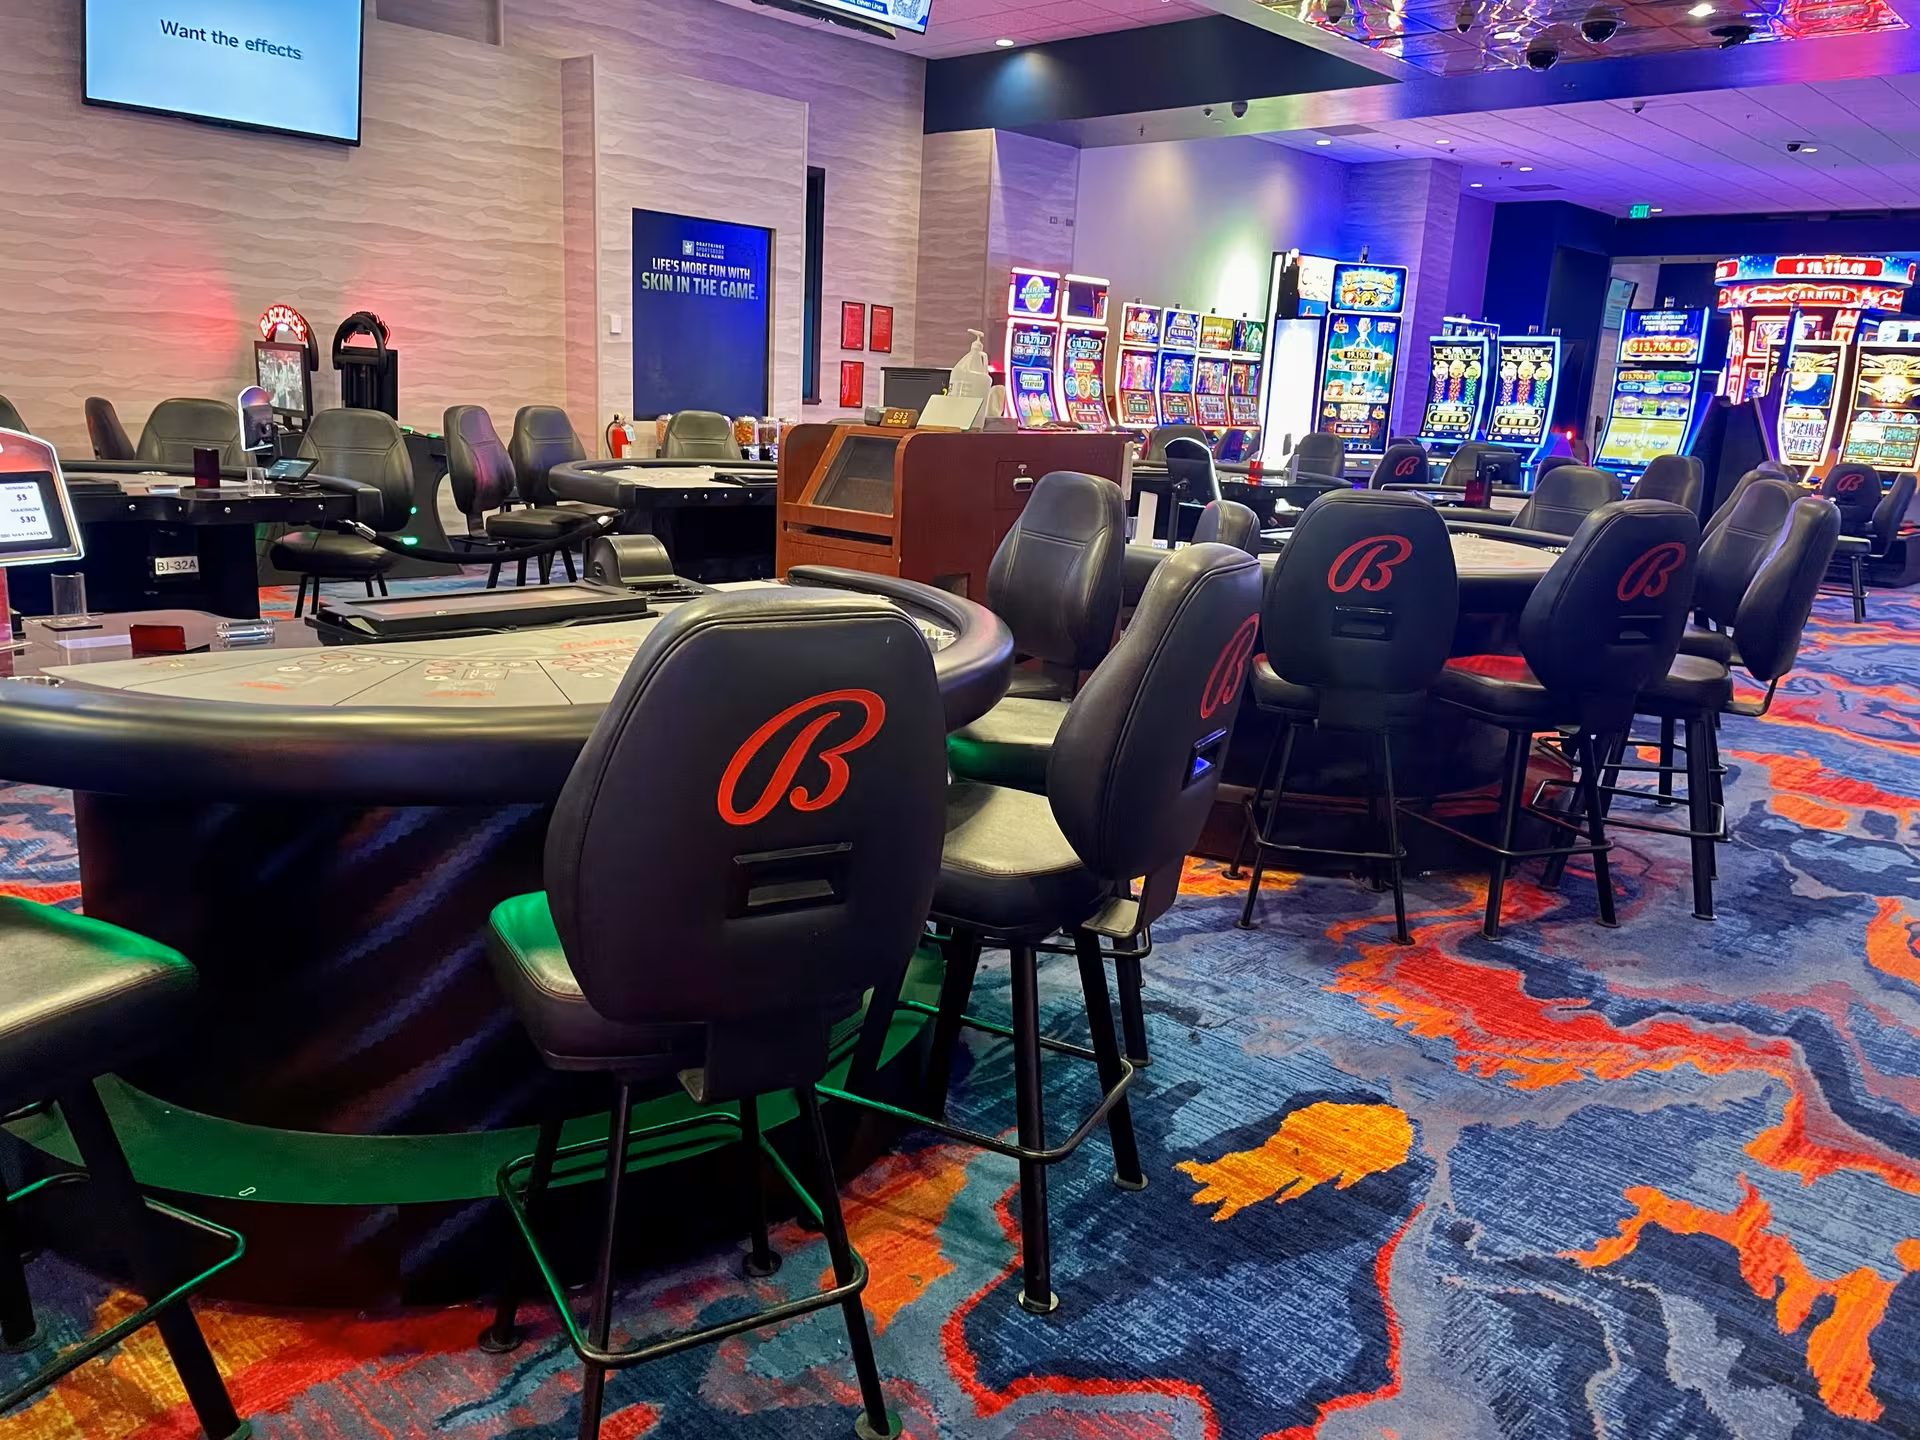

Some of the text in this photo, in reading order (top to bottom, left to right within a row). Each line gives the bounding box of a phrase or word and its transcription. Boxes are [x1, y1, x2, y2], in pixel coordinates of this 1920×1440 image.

[160, 19, 303, 60] Want the effects
[696, 241, 725, 249] DRAFTKINGS
[652, 257, 750, 280] LIFE'S MORE FUN WITH
[641, 272, 759, 300] SKIN IN THE GAME.
[1787, 289, 1851, 302] CARNIVAL
[259, 306, 306, 342] BLACKJACK
[1632, 341, 1688, 353] $13,706.89
[157, 559, 197, 572] BJ-32A
